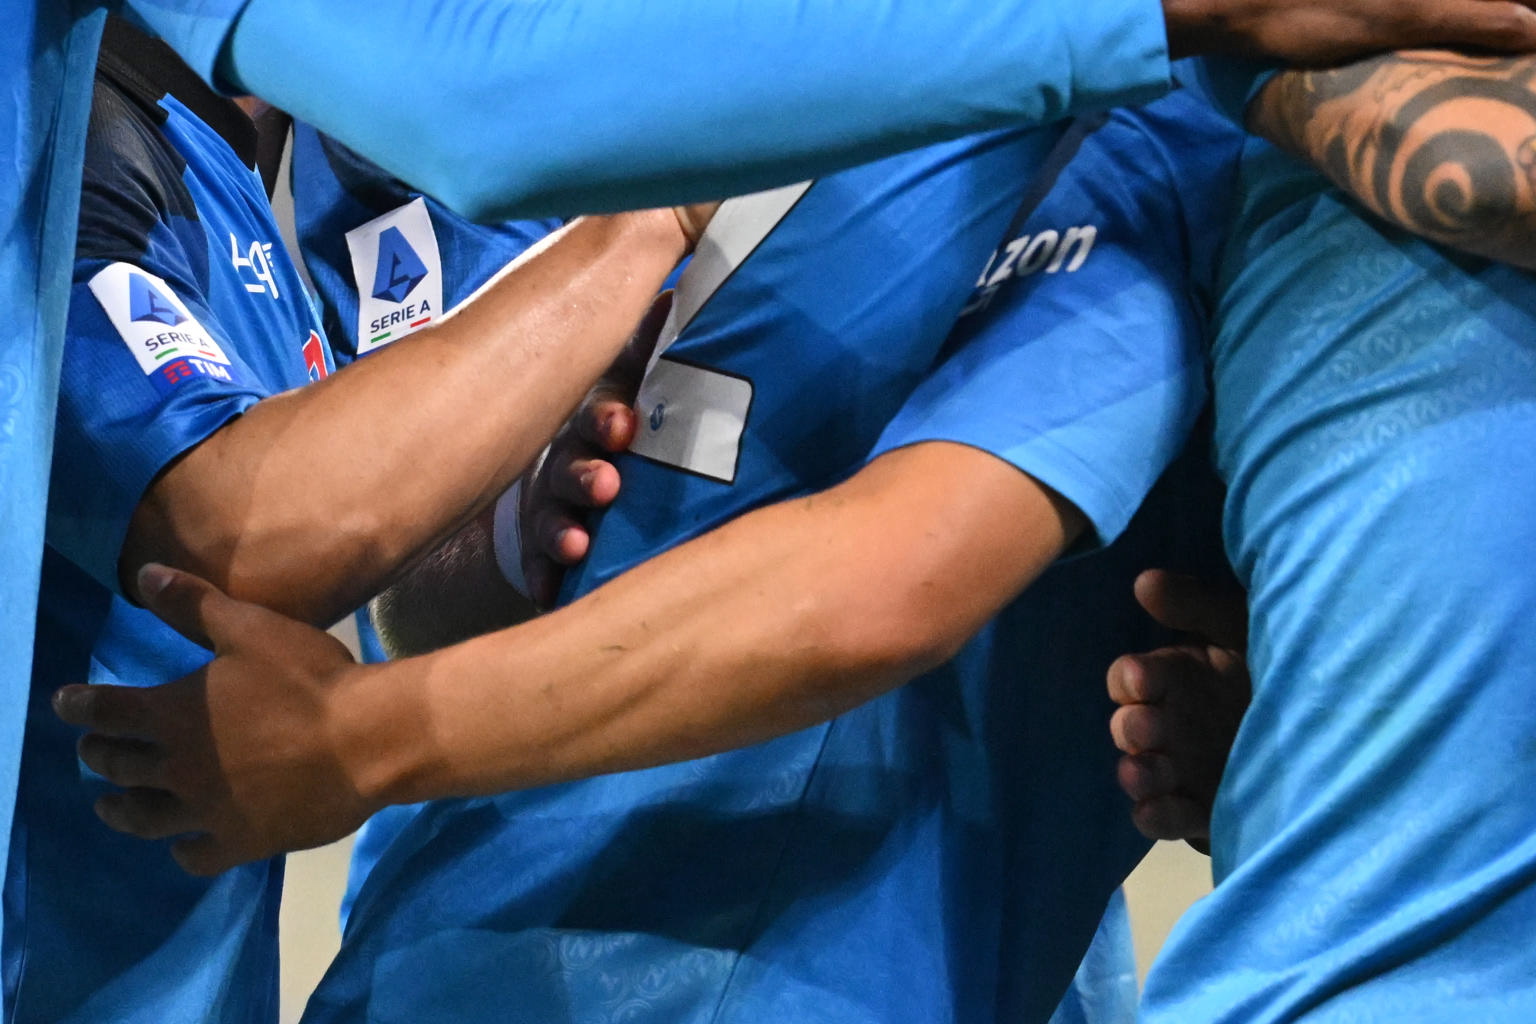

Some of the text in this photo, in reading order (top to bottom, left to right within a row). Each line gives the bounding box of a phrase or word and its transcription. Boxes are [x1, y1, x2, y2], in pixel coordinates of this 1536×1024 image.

[976, 225, 1098, 287] zon
[369, 299, 431, 333] SERIE A
[144, 332, 210, 352] SERIE A
[188, 358, 232, 381] TIM
